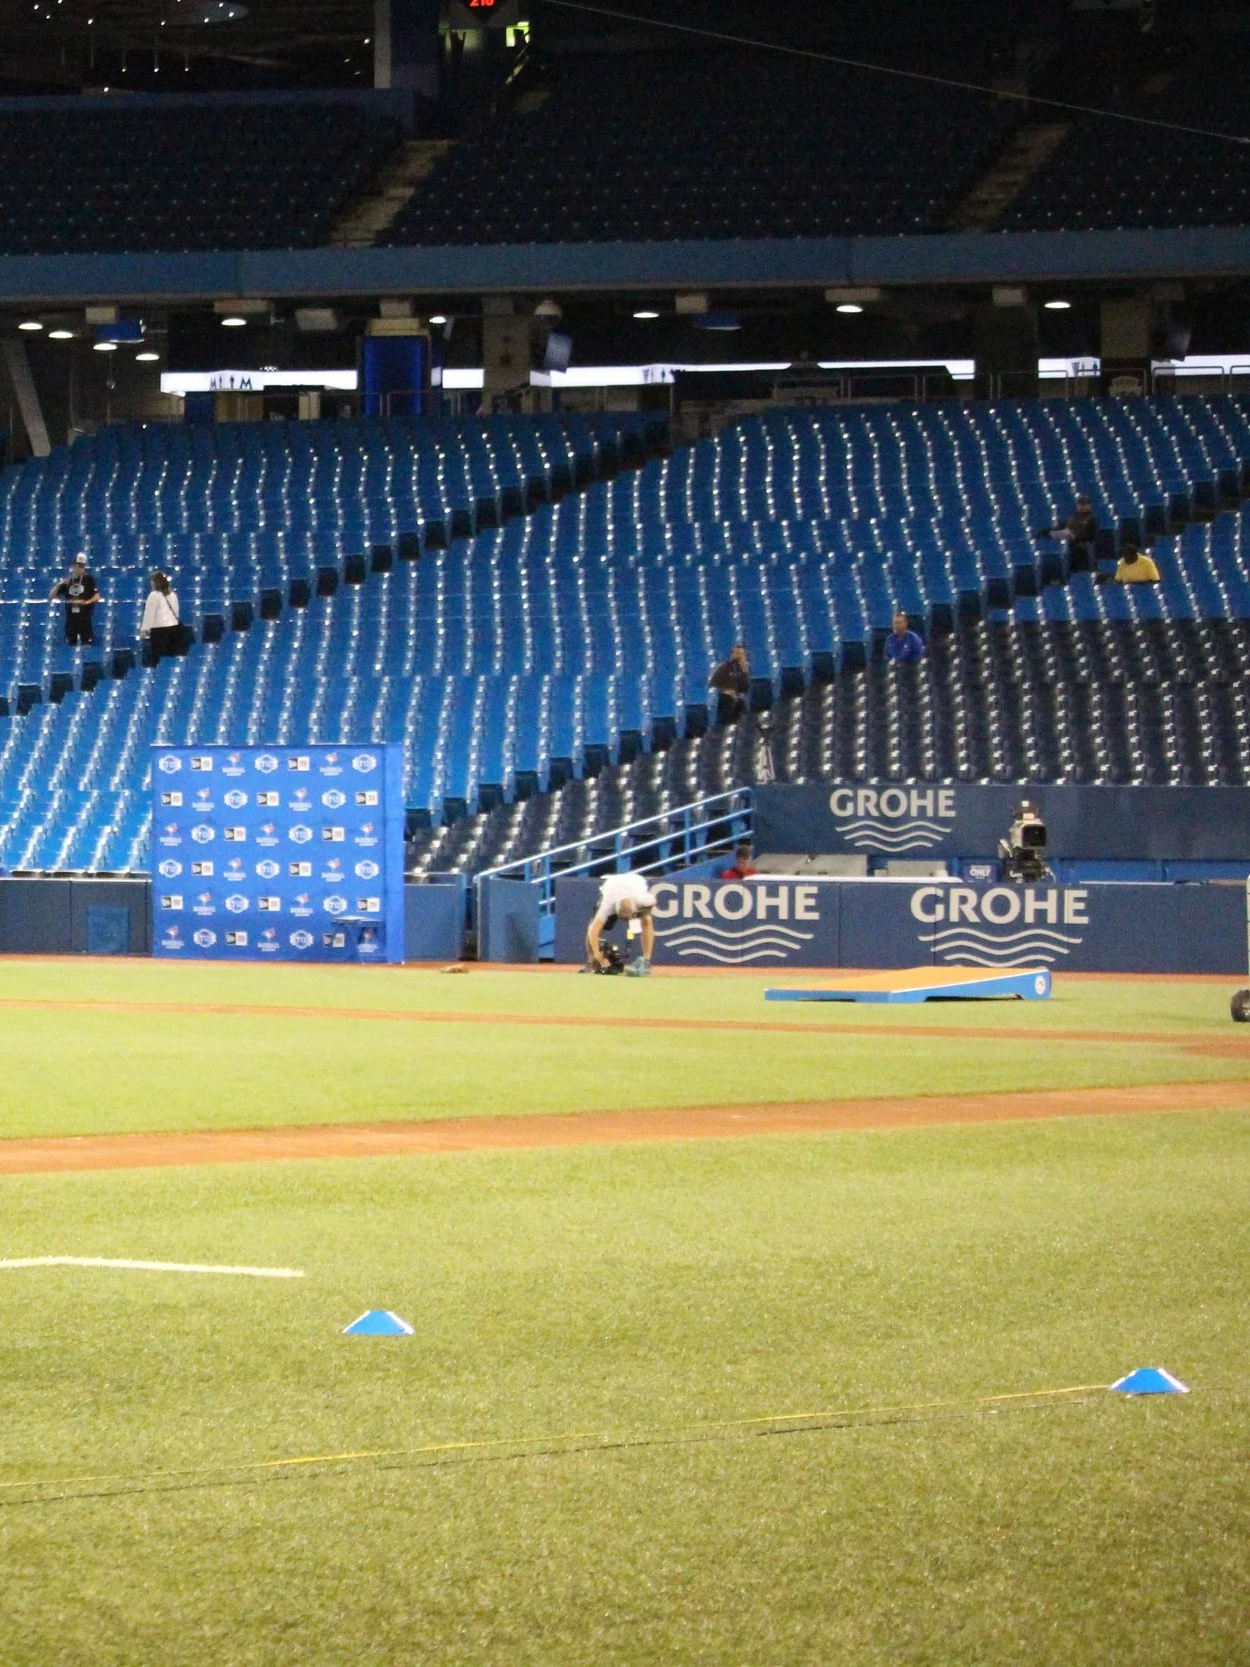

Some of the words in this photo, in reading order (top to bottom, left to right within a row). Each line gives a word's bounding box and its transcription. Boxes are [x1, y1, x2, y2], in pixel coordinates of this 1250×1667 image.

[829, 788, 956, 818] GROHE
[650, 883, 820, 920] GROHE
[910, 886, 1090, 924] GROHE
